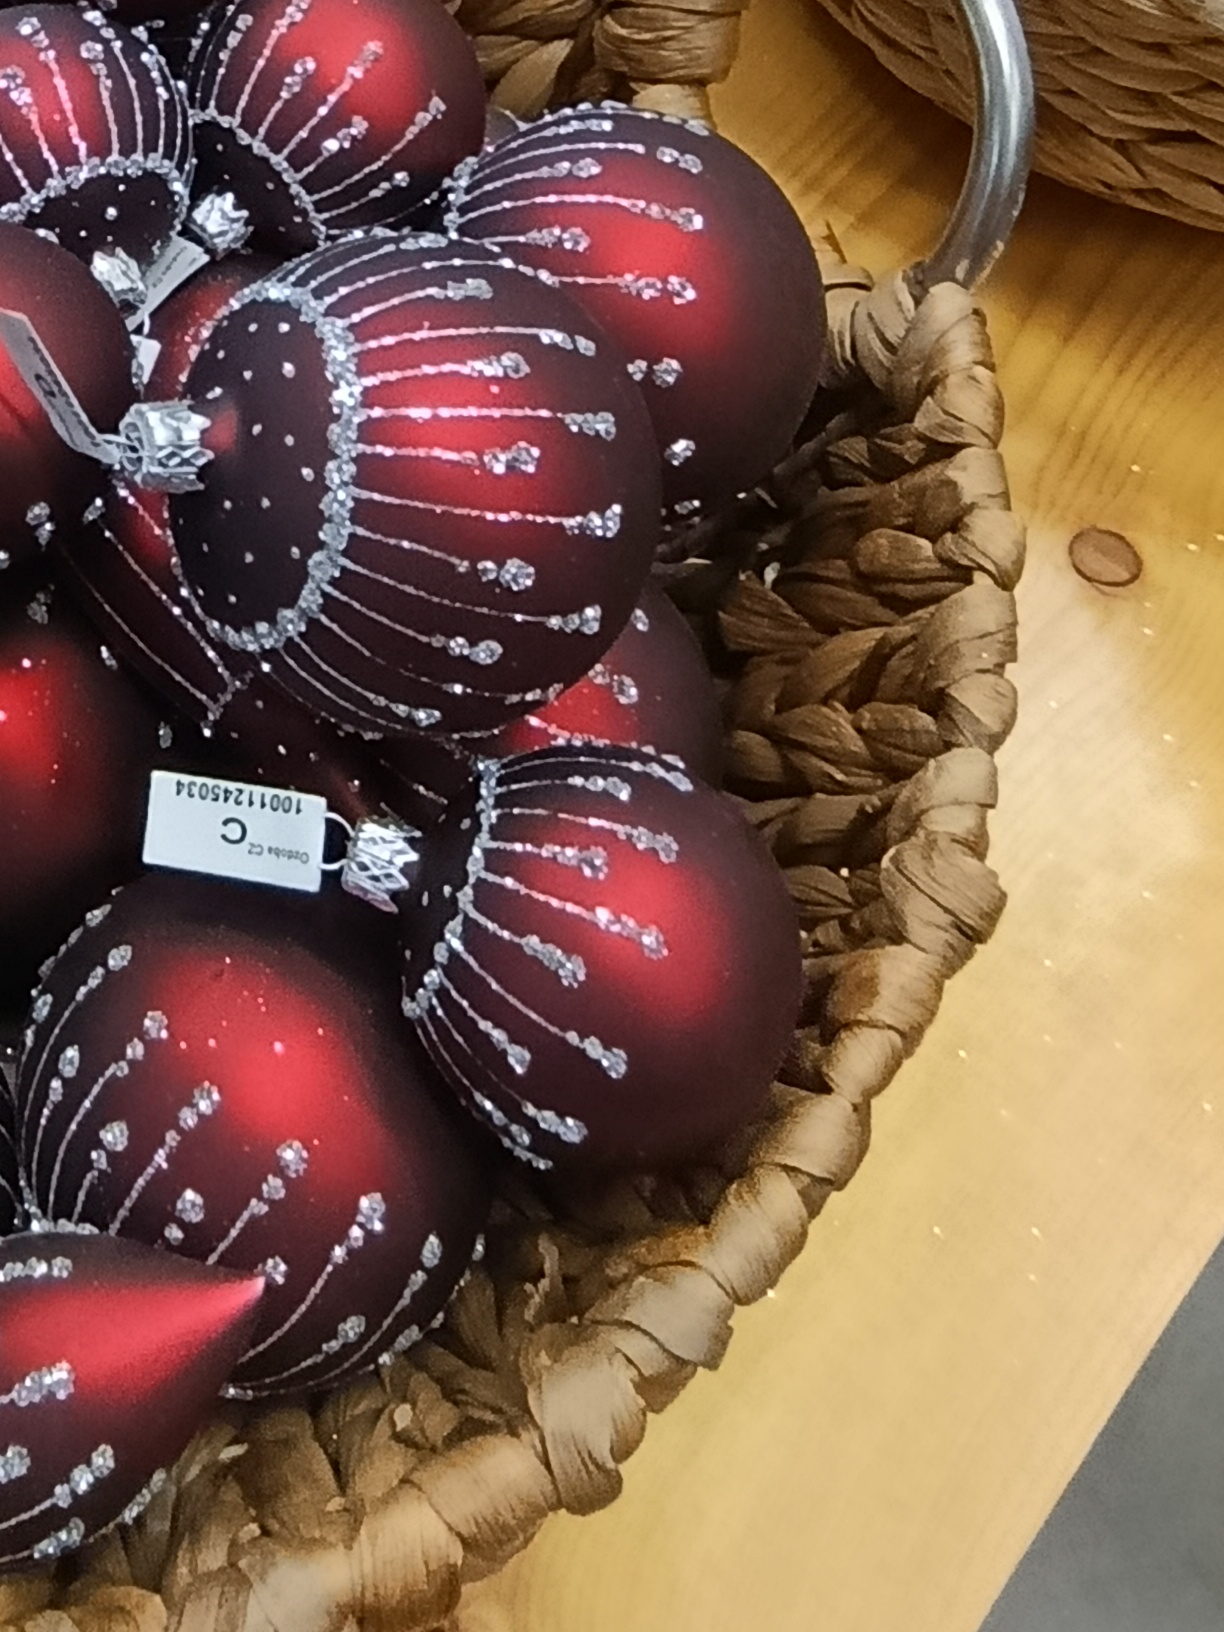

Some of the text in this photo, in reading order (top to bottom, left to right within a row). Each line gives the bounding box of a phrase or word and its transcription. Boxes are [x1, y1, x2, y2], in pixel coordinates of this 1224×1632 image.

[175, 779, 302, 815] 10011245034
[220, 817, 247, 844] C
[247, 842, 309, 864] Ozdoba CZ
